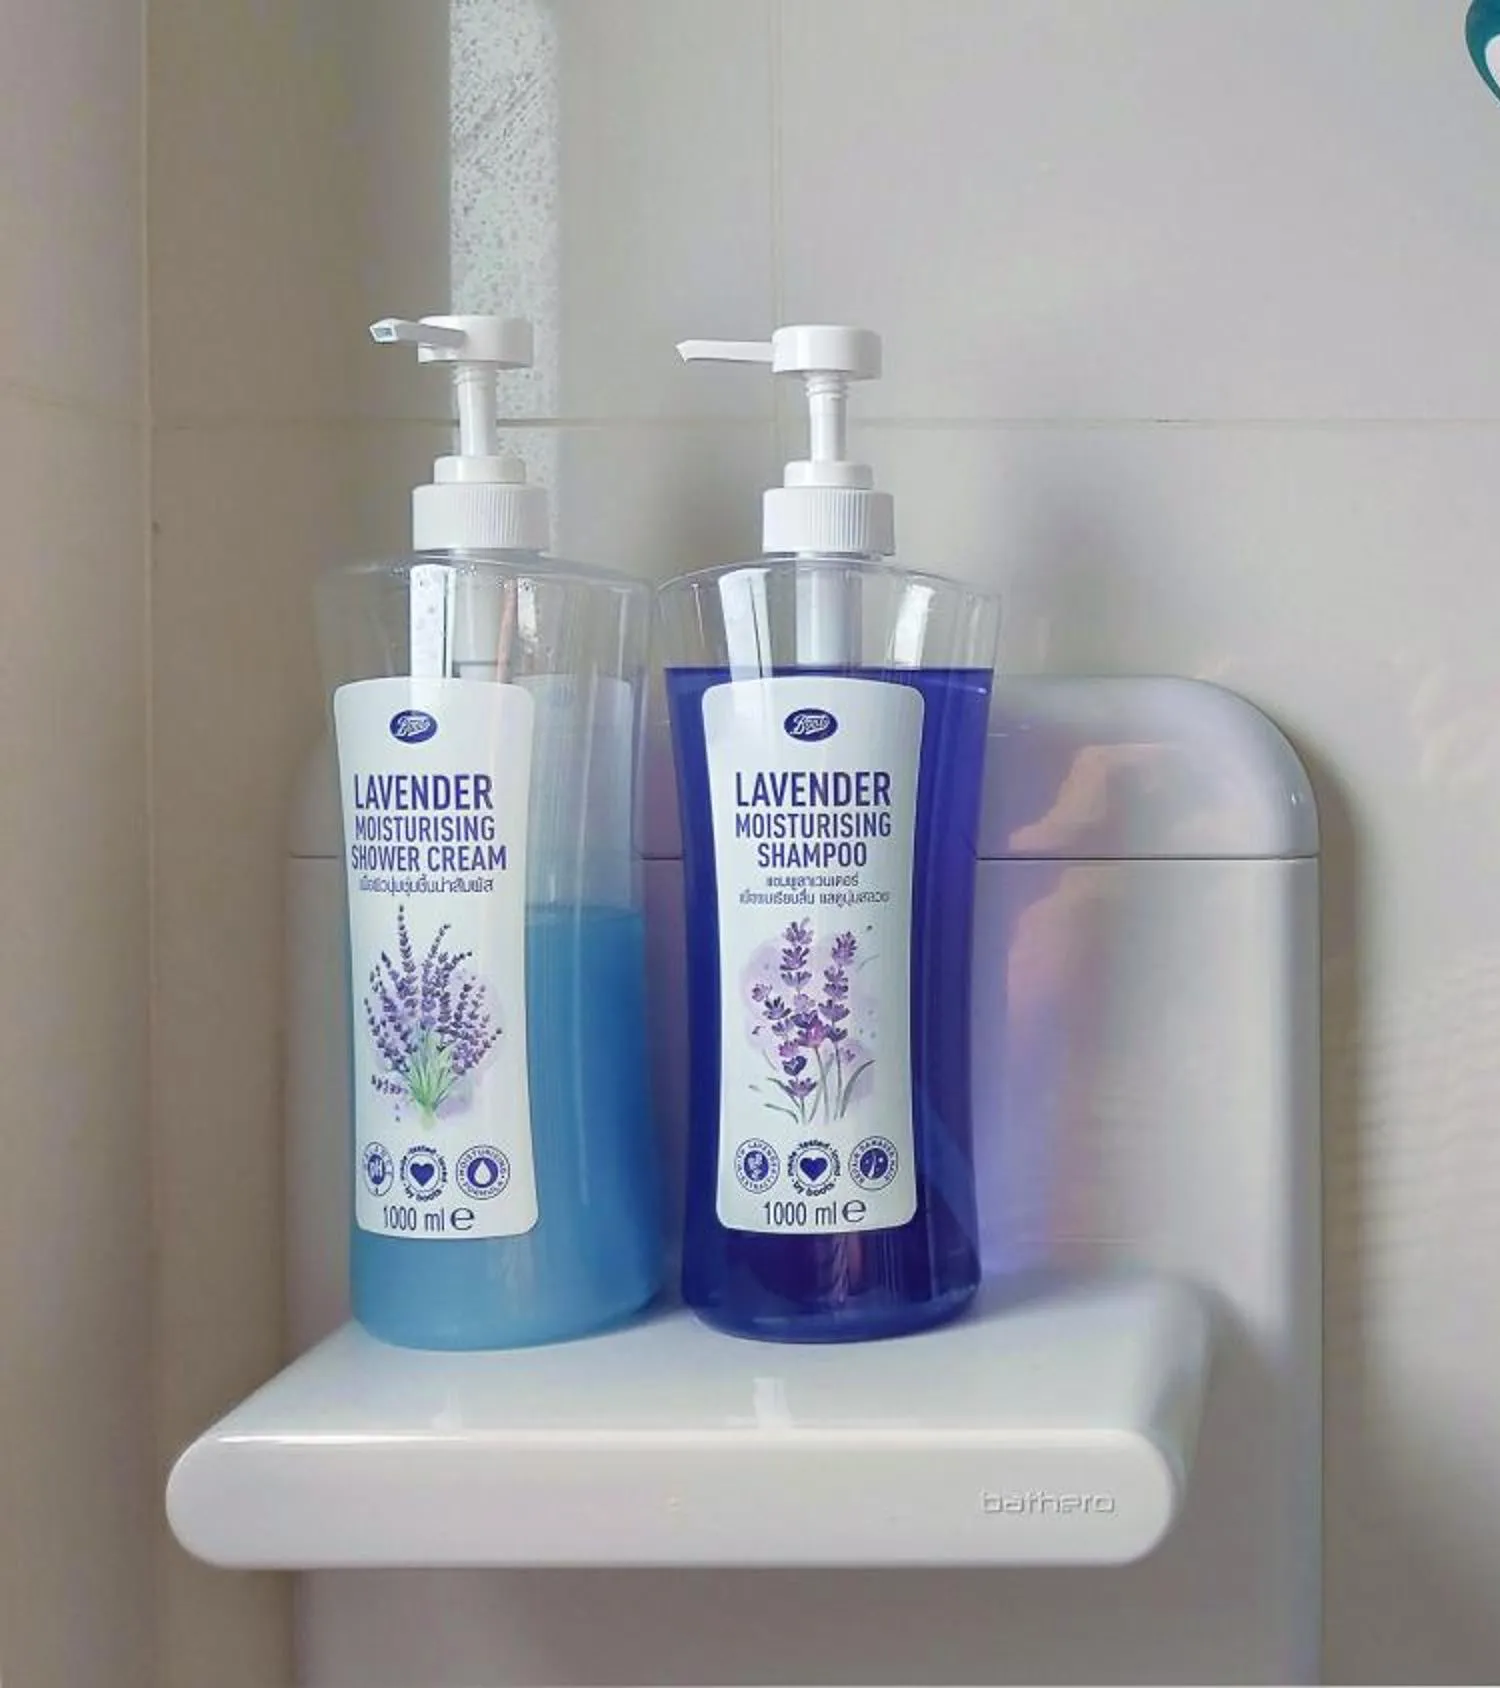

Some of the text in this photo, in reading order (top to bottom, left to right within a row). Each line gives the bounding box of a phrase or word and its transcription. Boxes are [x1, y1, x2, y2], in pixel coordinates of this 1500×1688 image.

[354, 773, 494, 811] LAVENDER
[735, 771, 892, 807] LAVENDER
[354, 815, 496, 842] MOISTURISING
[735, 811, 892, 839] MOISTURISING
[351, 844, 508, 871] SHOWER CREAM
[757, 841, 868, 868] SHAMPOO
[383, 1205, 417, 1231] 1000
[424, 1207, 445, 1232] ml
[764, 1201, 807, 1226] 1000
[815, 1202, 837, 1226] ml
[982, 1489, 1116, 1513] bathero
